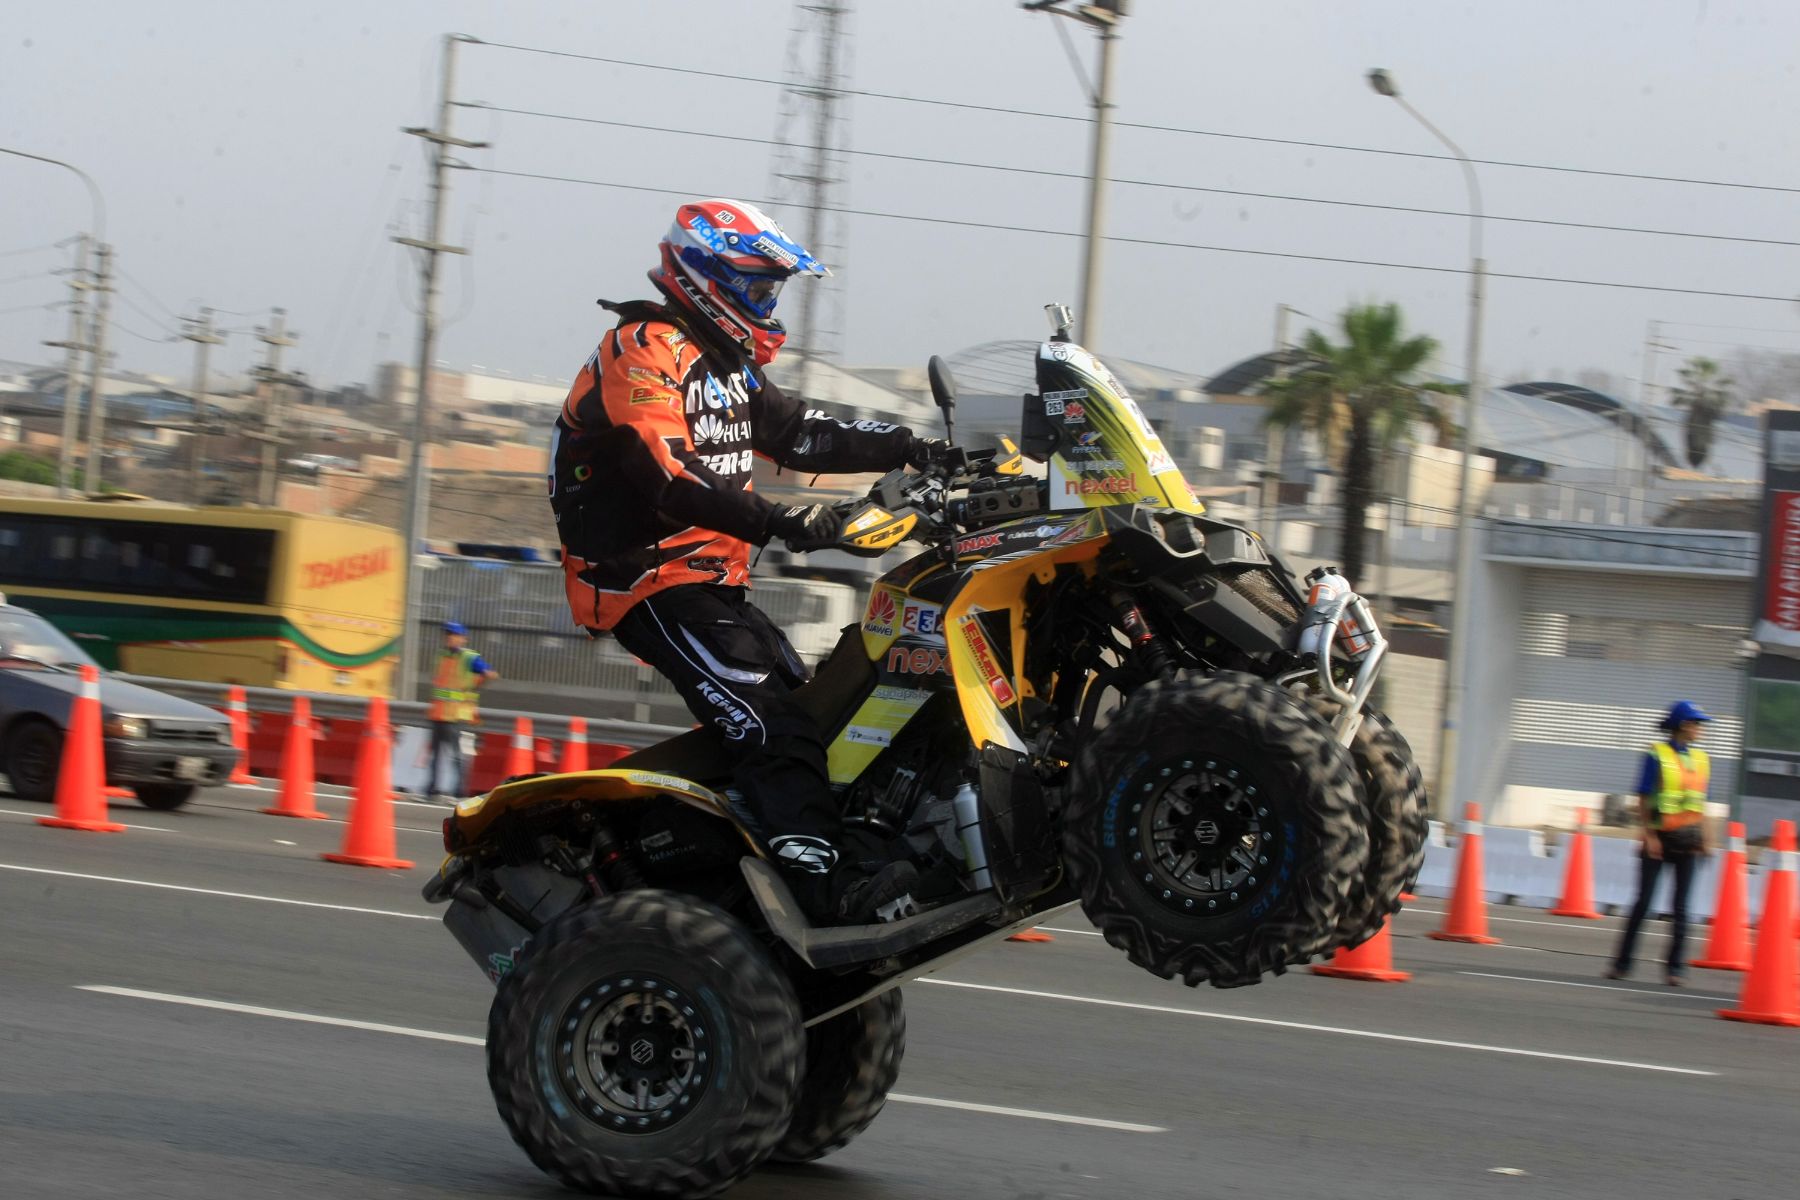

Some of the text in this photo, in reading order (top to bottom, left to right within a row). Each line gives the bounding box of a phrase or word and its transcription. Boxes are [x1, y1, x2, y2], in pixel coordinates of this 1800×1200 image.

[717, 211, 733, 223] 263
[690, 215, 727, 254] TECHO
[1048, 401, 1063, 414] 263
[723, 420, 752, 443] HUA
[1064, 473, 1138, 495] nextel
[864, 623, 893, 637] HUAWEI
[965, 622, 998, 678] Elka
